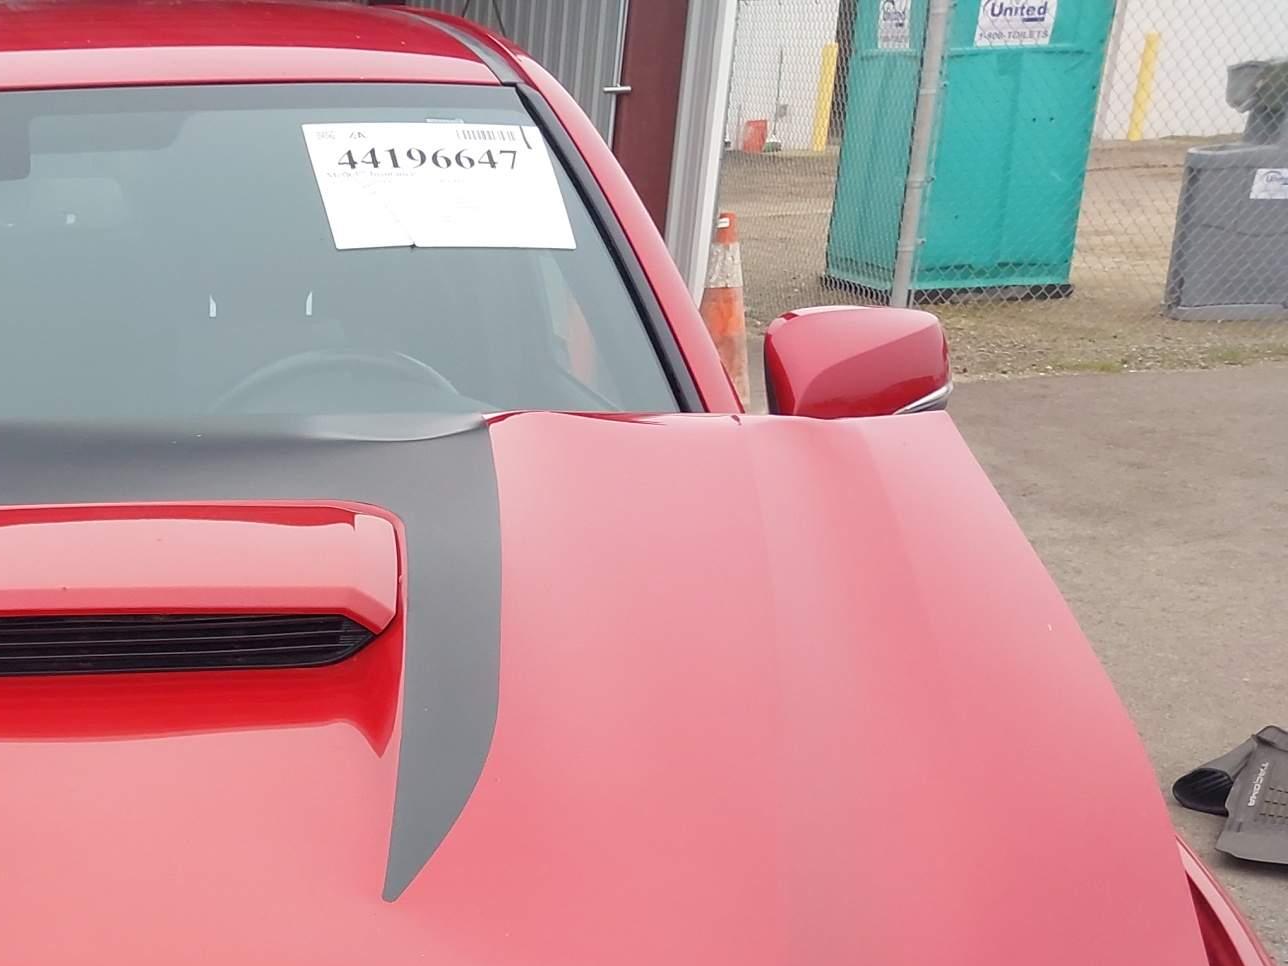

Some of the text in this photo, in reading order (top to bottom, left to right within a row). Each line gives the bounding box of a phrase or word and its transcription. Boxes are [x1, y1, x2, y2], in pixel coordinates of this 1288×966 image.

[990, 1, 1048, 17] United
[337, 147, 518, 170] 44196647
[1247, 762, 1270, 807] TACOMA
